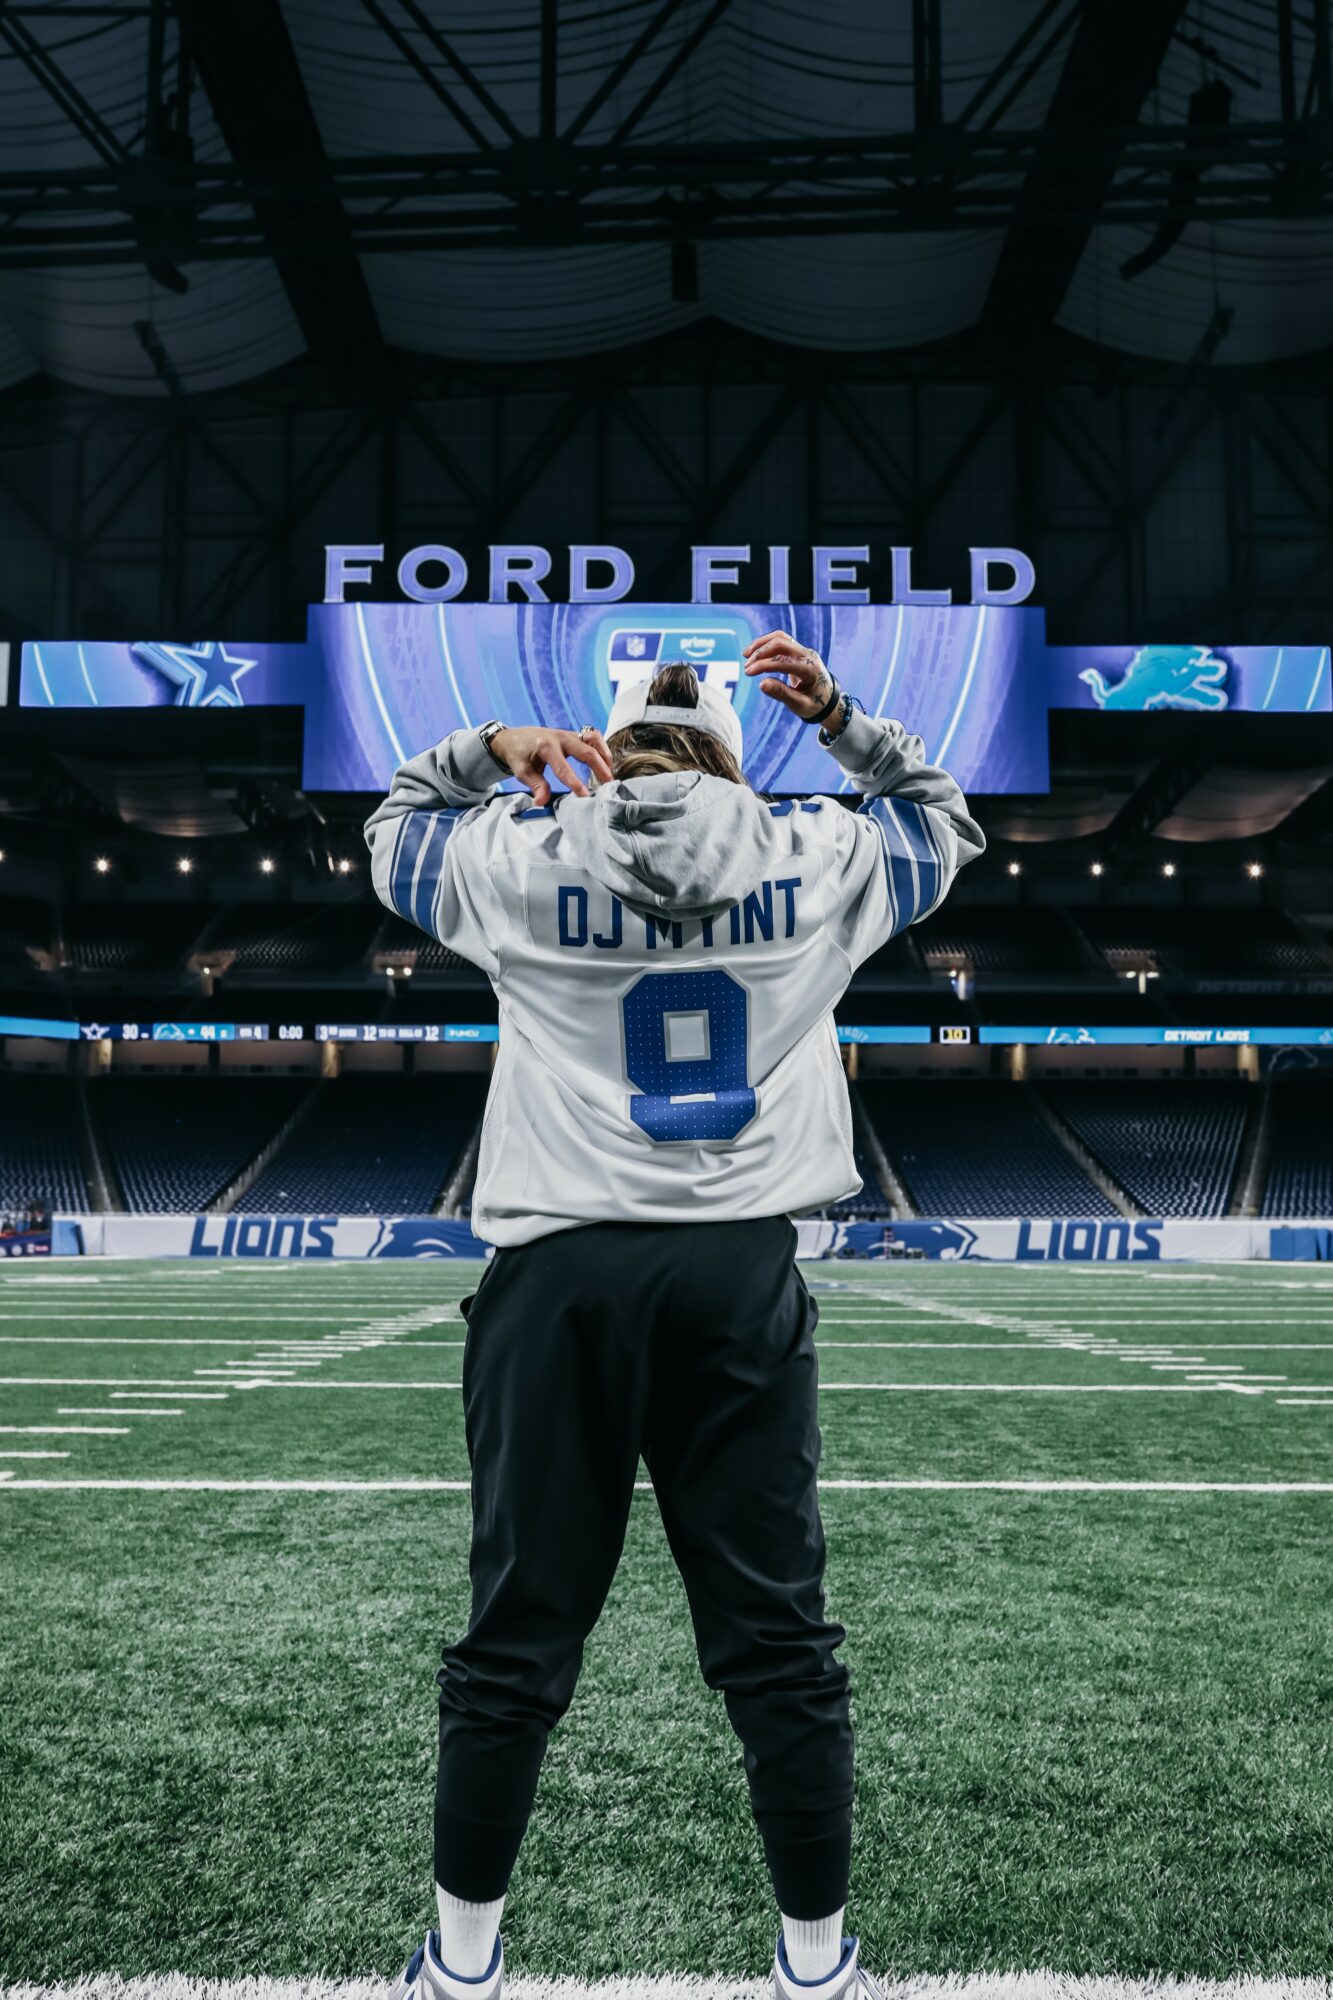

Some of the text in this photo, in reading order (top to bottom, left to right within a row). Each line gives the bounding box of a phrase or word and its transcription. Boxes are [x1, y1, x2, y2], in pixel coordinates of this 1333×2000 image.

[323, 544, 1036, 605] FORD FIELD
[680, 636, 716, 651] prime
[558, 885, 623, 949] DJ
[122, 1023, 139, 1040] 30
[200, 1024, 216, 1040] 44
[279, 1025, 303, 1040] 0:00
[363, 1025, 377, 1041] 12
[425, 1025, 439, 1041] 12
[945, 1028, 964, 1041] 10
[1164, 1030, 1250, 1042] DETROIT LIONS
[189, 1216, 338, 1257] LIONS
[1016, 1219, 1164, 1260] LIONS
